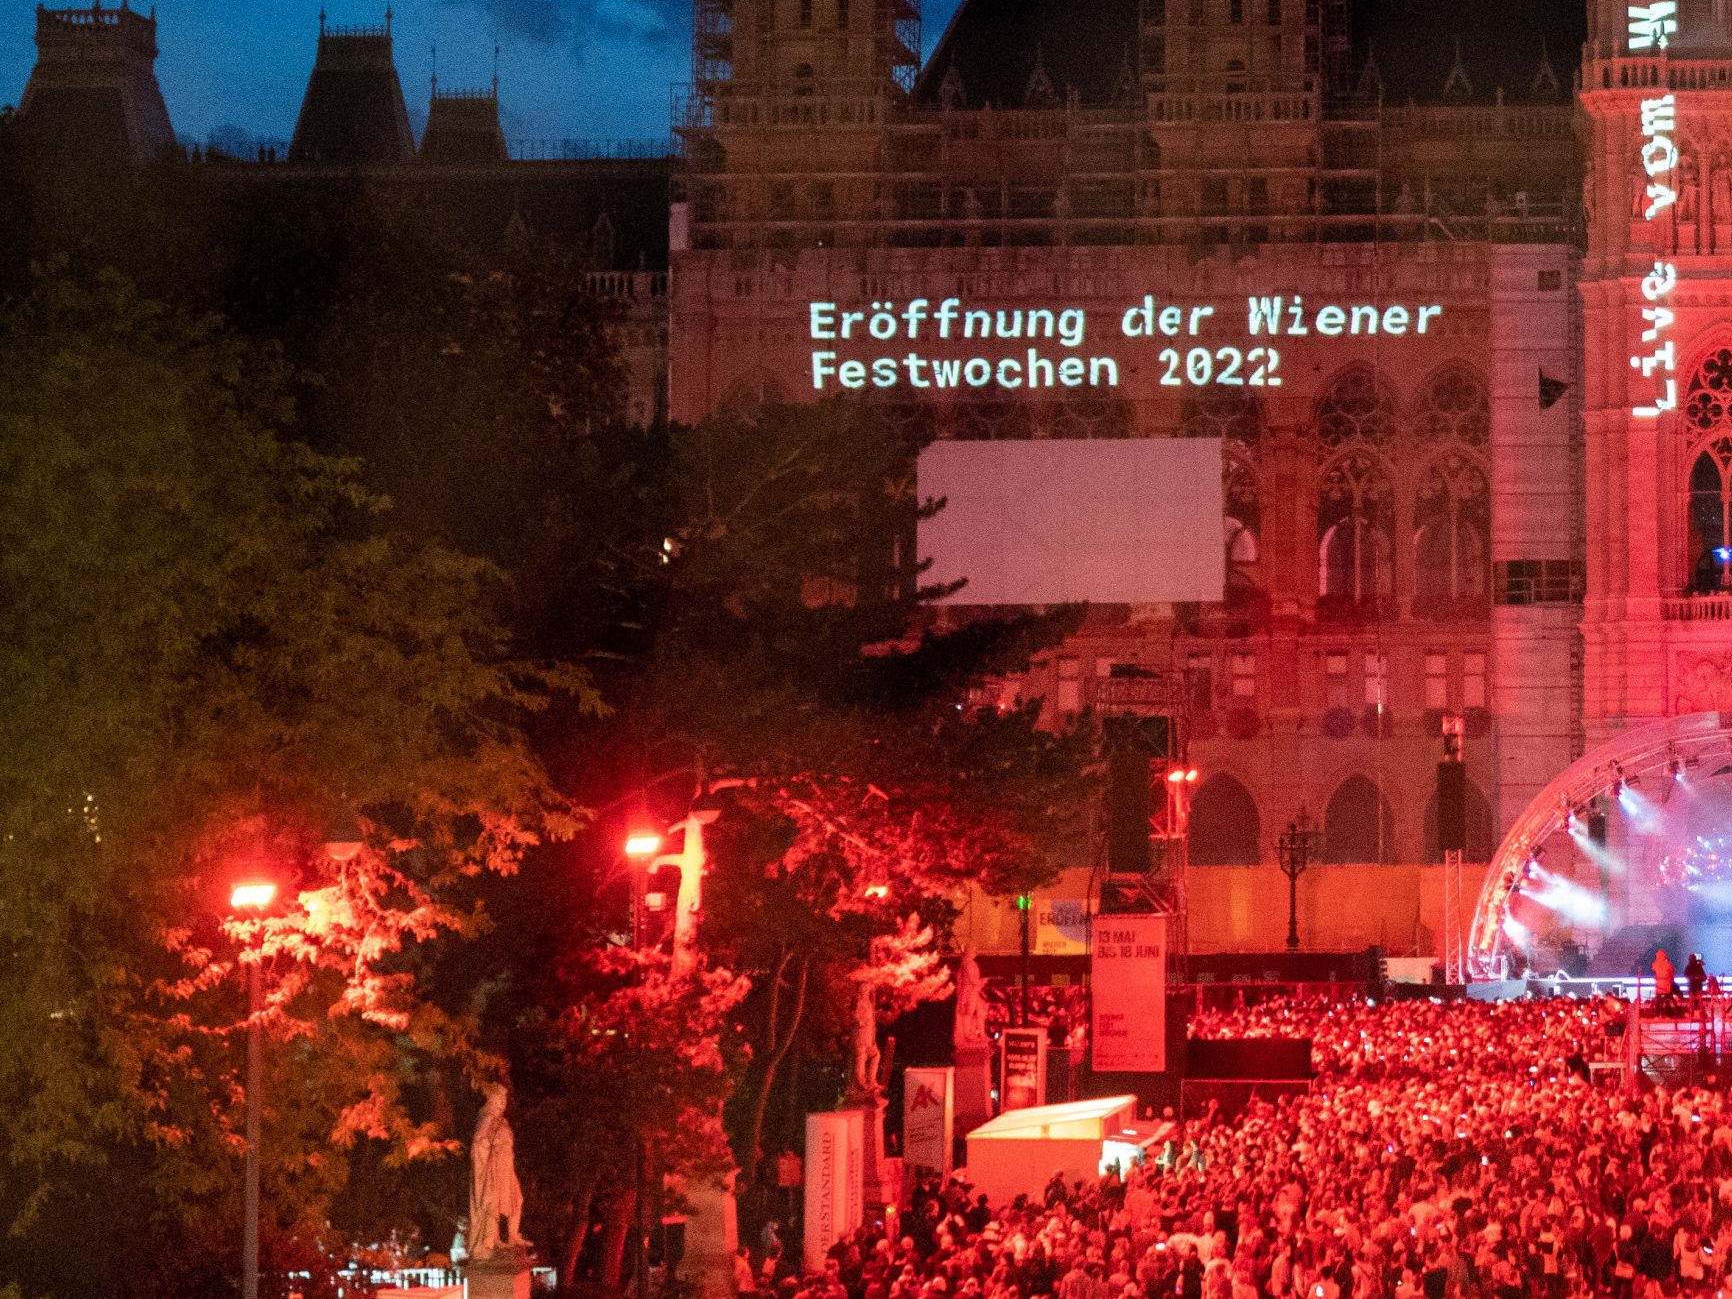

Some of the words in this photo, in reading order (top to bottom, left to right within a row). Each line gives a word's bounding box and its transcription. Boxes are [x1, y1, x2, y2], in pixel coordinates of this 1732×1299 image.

[1640, 93, 1679, 221] vom
[809, 298, 1085, 347] Eröffnung
[1121, 295, 1214, 337] der
[1248, 295, 1442, 336] Wiener
[1630, 261, 1678, 418] Live
[811, 349, 1118, 390] Festwochen
[1158, 347, 1282, 387] 2022
[1098, 930, 1110, 943] 13
[1135, 945, 1160, 958] JUNI
